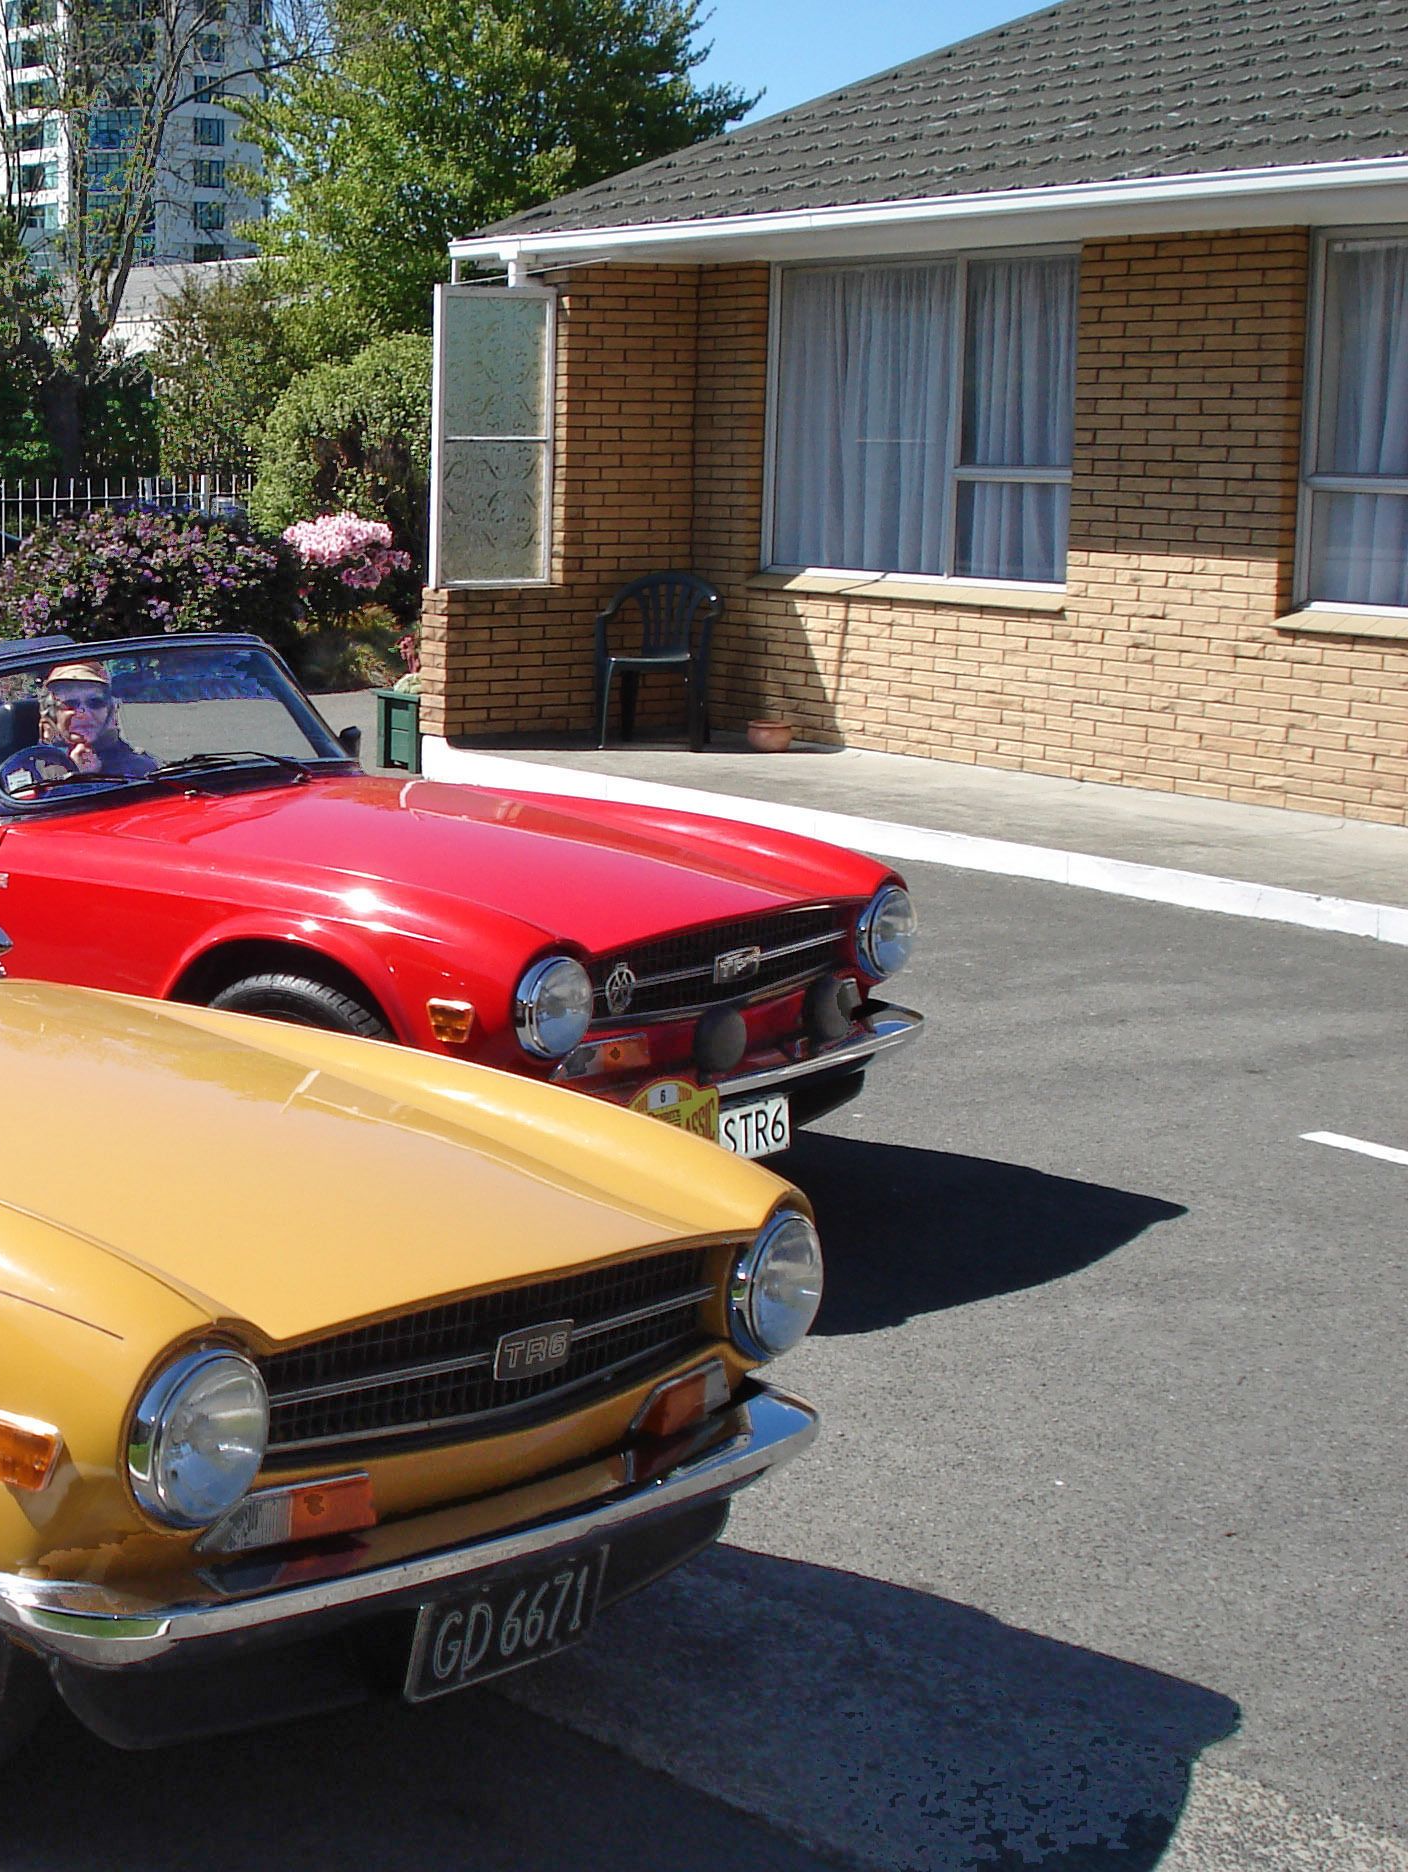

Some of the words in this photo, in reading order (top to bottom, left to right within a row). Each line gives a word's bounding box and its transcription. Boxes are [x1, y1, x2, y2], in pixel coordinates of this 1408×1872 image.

[659, 1089, 667, 1104] 6
[723, 1103, 786, 1154] STR6
[504, 1330, 569, 1369] TR6
[499, 1565, 590, 1656] 6671
